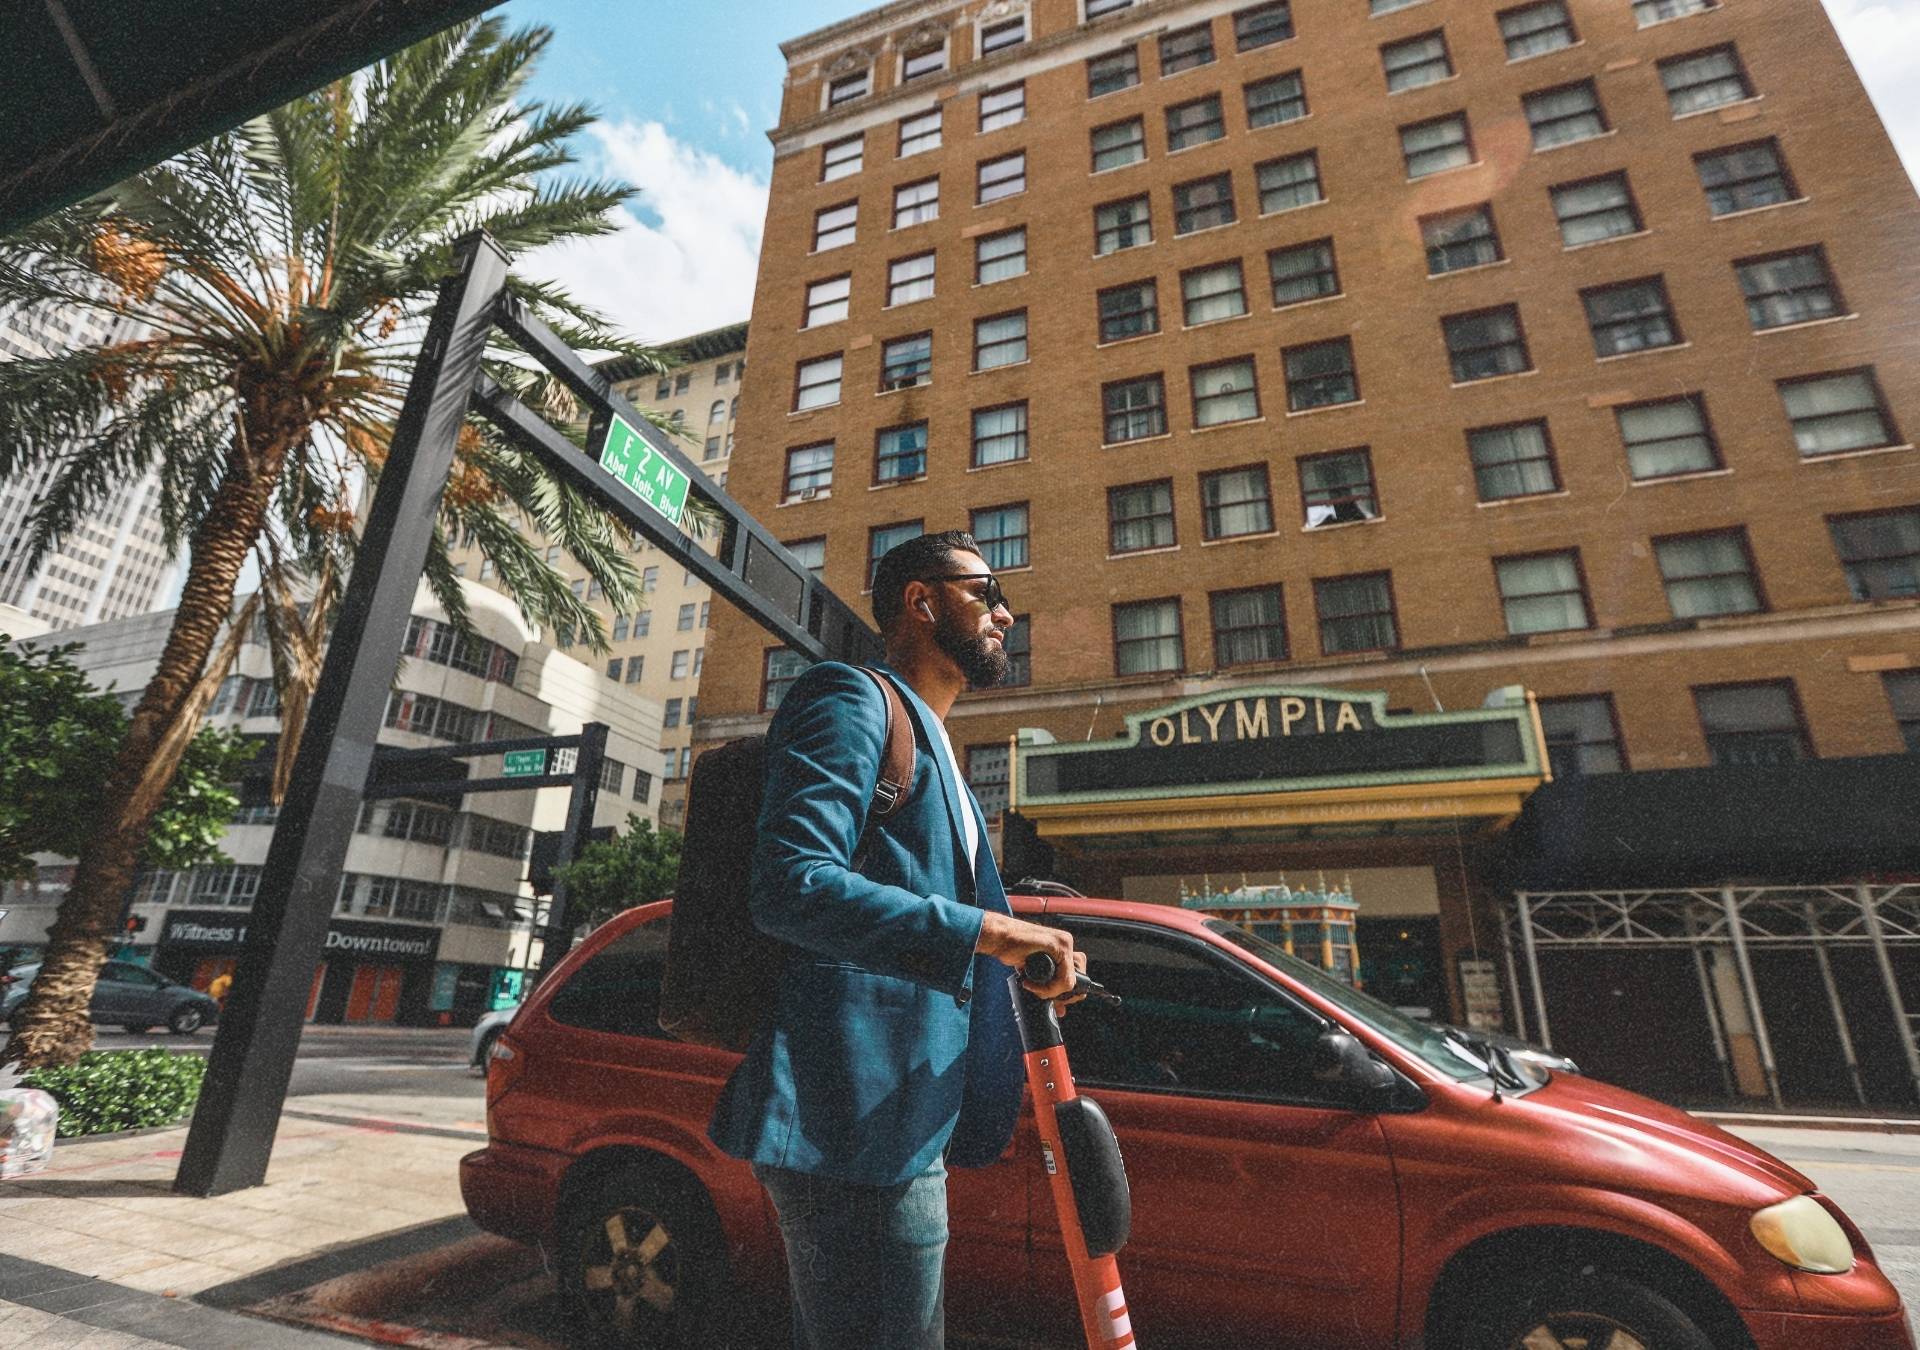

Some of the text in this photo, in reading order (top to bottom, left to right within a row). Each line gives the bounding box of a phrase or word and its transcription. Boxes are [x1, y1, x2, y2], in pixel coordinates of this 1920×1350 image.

[606, 451, 678, 518] Abel Holtz Blvd
[623, 435, 675, 491] E 2 AV
[1150, 698, 1362, 745] OLYMPIA
[1151, 813, 1211, 828] CENTER
[1219, 811, 1250, 824] FOR
[170, 923, 234, 941] Witness
[325, 931, 432, 956] Downtown!
